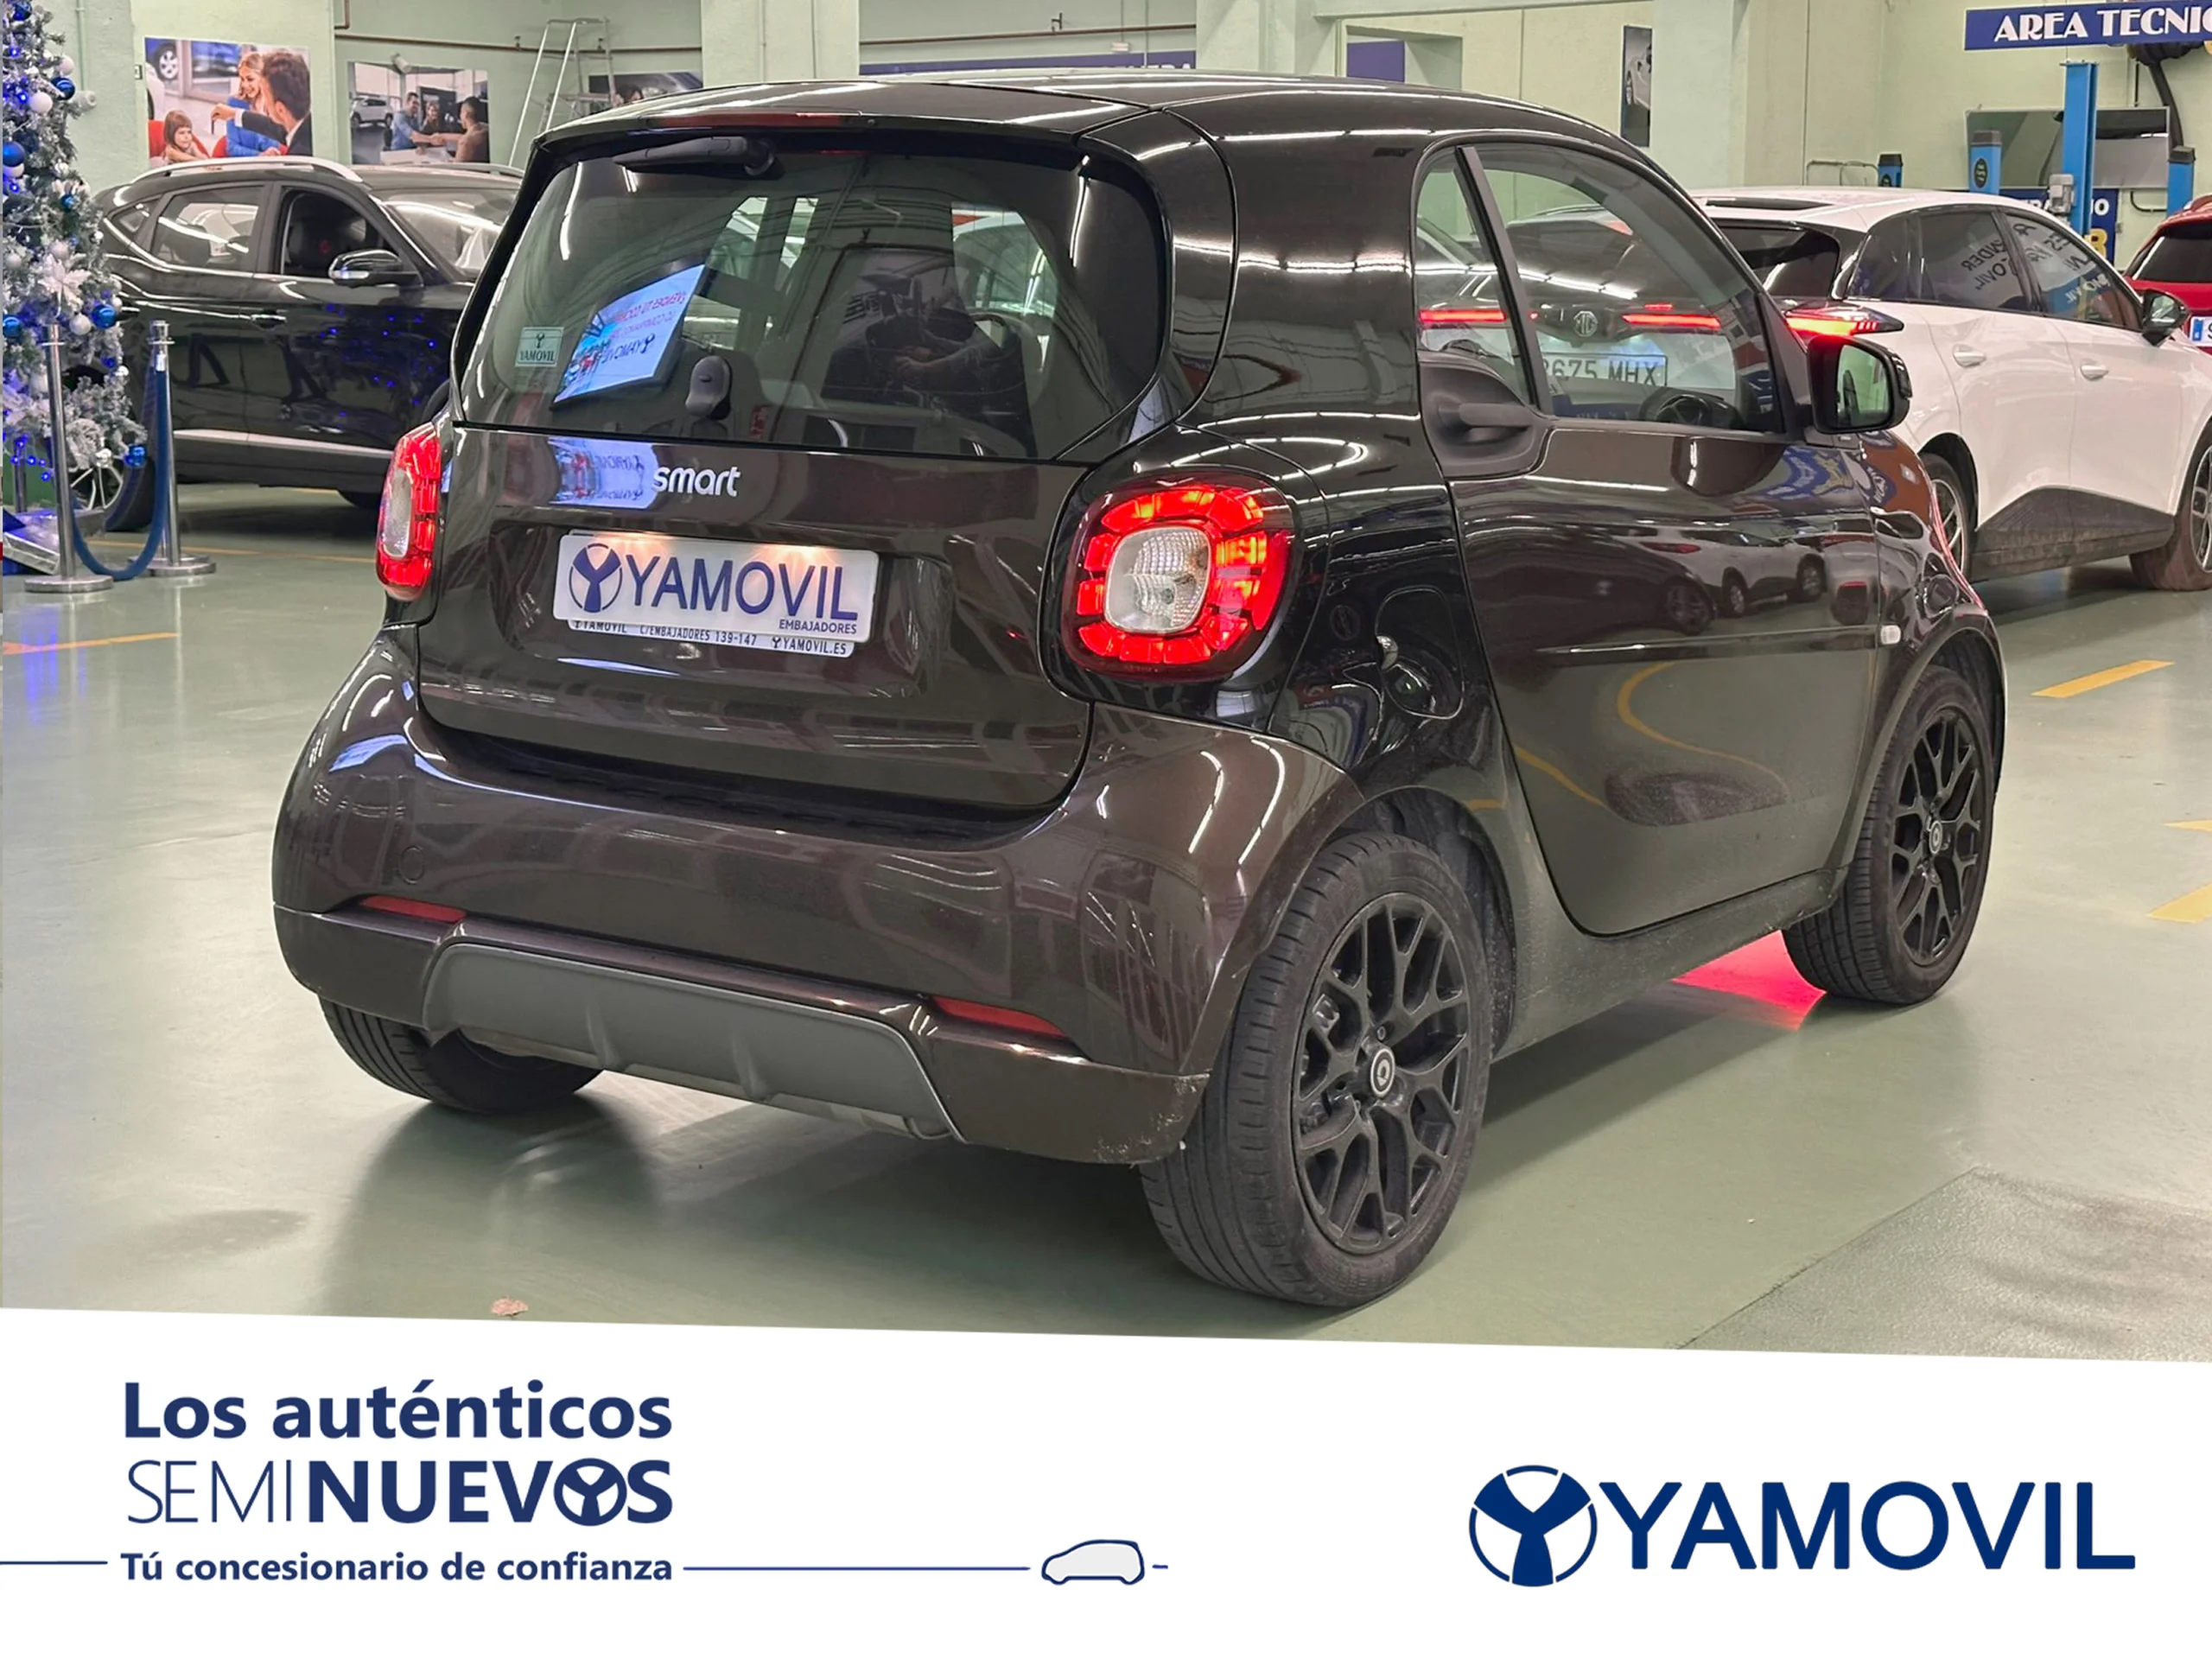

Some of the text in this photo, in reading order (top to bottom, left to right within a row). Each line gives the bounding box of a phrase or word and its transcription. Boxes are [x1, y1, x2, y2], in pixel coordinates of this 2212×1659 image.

[1993, 12, 2088, 41] AREA
[1573, 310, 1599, 338] MG
[520, 350, 555, 361] YAMOVIL
[1609, 361, 1659, 386] MHX
[653, 466, 741, 497] smart
[626, 555, 858, 620] YAMOVIL
[639, 624, 710, 641] C/EMBAJADORES
[715, 631, 757, 645] 139-147
[783, 638, 847, 655] YAMOVIL.ES
[779, 619, 857, 634] EMBAJADORES
